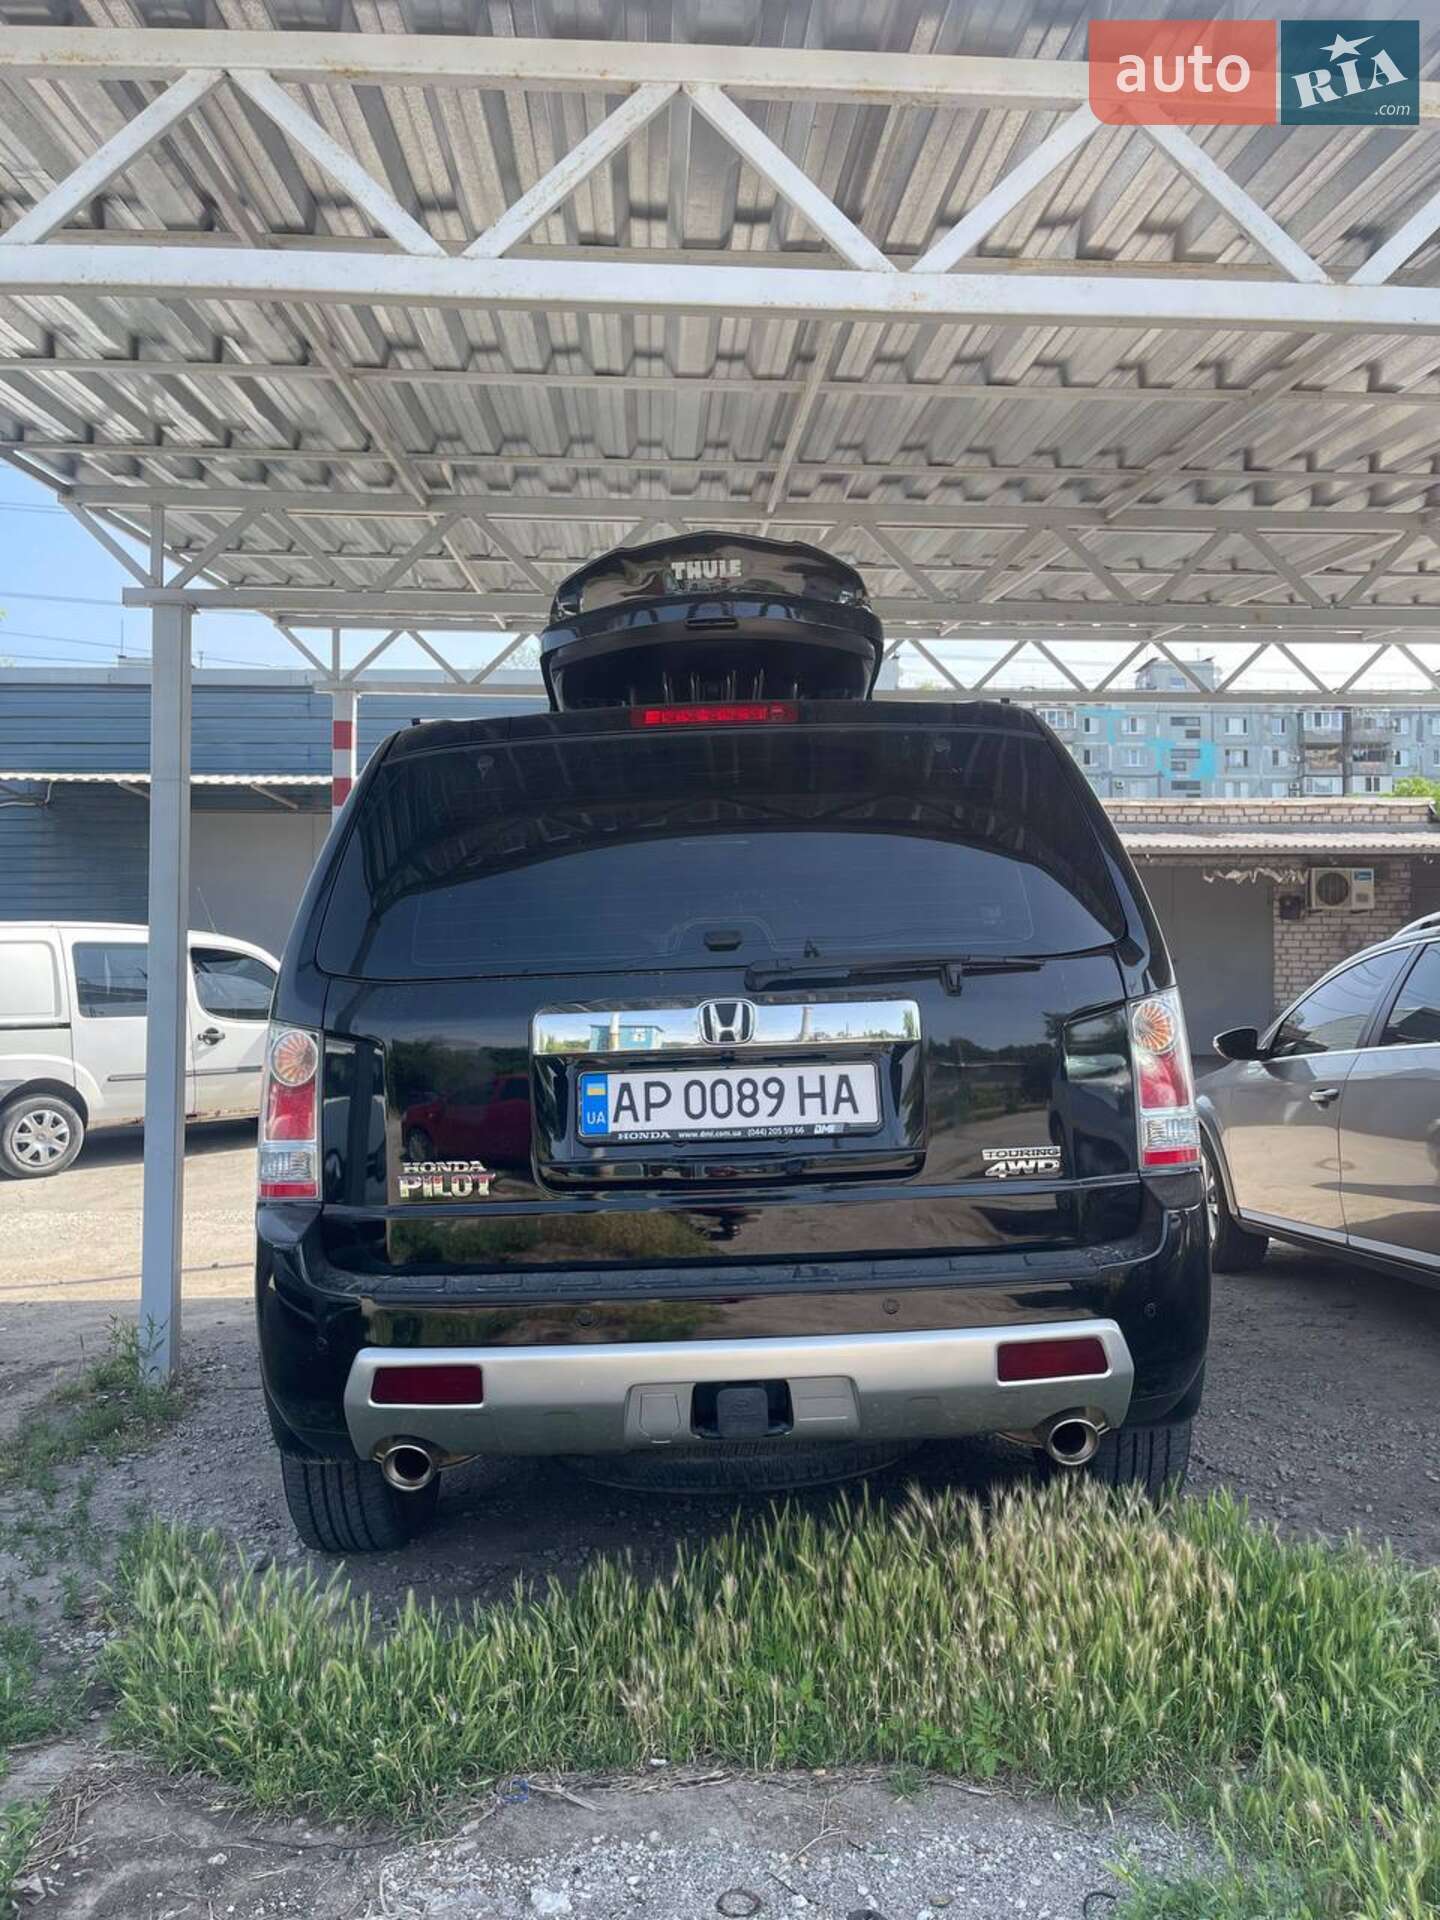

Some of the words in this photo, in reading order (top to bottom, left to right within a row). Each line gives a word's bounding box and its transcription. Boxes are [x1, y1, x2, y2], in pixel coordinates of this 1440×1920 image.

[671, 559, 742, 580] THULE
[612, 1080, 672, 1123] AP
[683, 1076, 786, 1120] 0089
[797, 1073, 860, 1117] HA
[587, 1111, 607, 1125] UA
[617, 1130, 671, 1140] HONDA
[983, 1148, 1060, 1159] TOURING
[402, 1160, 487, 1174] HONDA
[985, 1160, 1061, 1178] 4WD
[398, 1173, 496, 1198] PILOT
